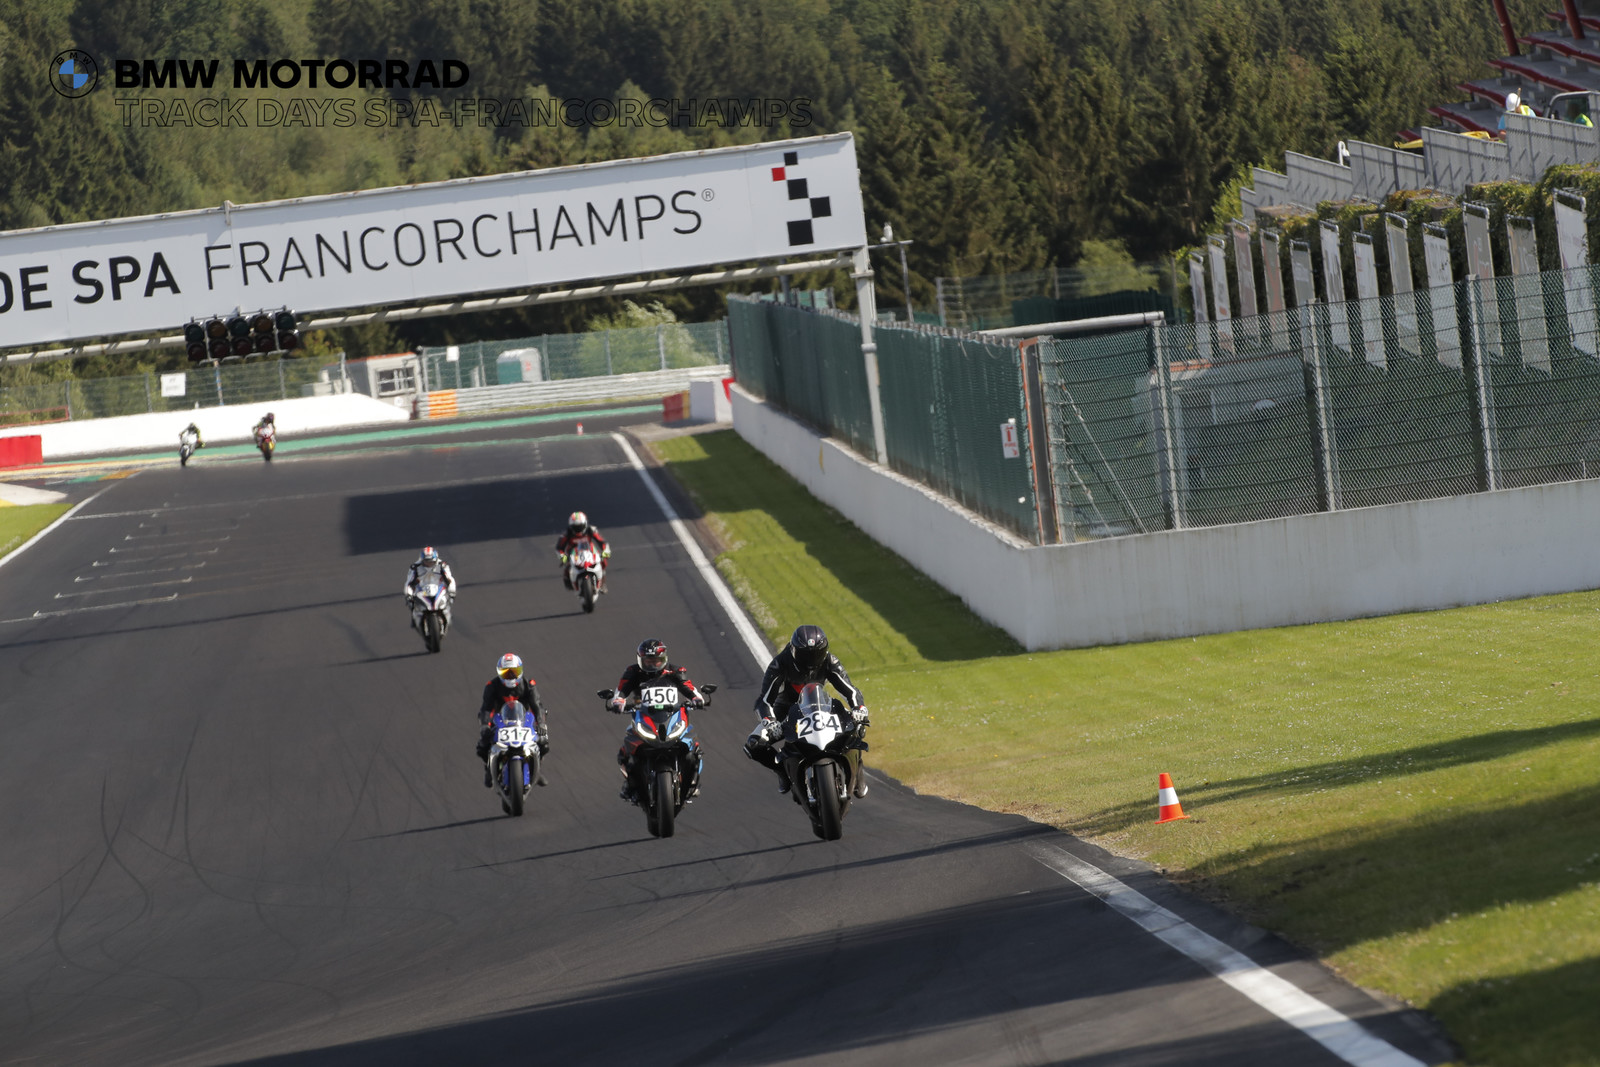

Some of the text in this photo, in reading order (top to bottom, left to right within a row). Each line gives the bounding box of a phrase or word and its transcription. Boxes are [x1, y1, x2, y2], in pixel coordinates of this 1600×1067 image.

[72, 252, 181, 304] SPA
[642, 688, 676, 705] 450
[500, 728, 530, 742] 317
[799, 712, 840, 737] 284
